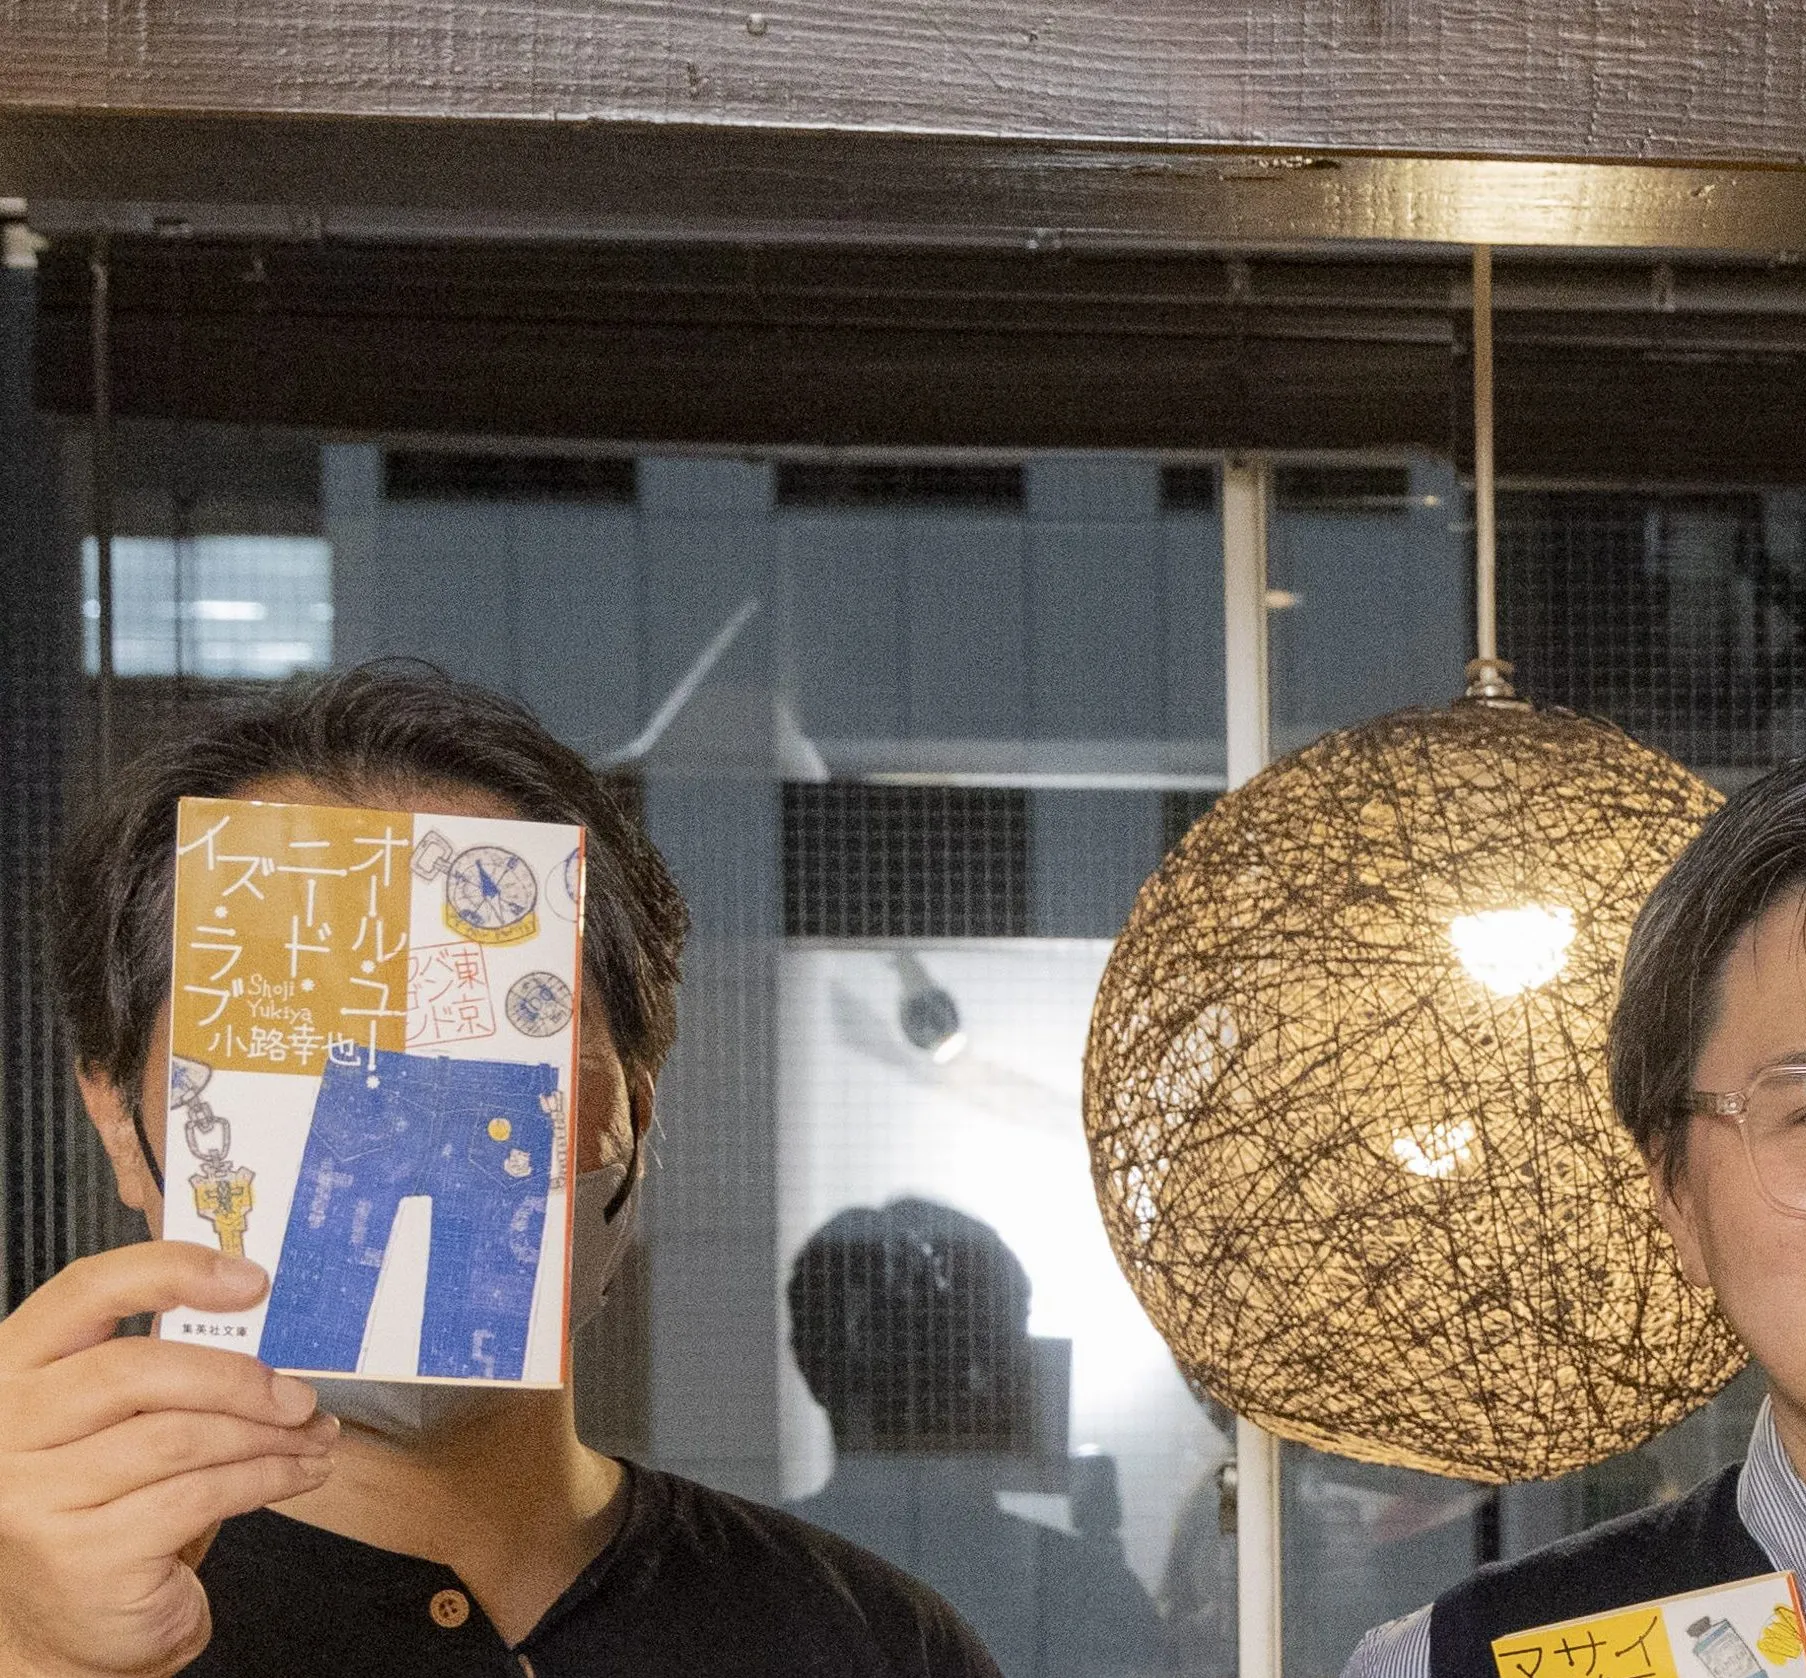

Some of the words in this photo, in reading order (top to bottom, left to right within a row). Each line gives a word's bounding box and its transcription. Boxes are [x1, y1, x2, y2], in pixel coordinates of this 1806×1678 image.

[248, 973, 297, 1001] Shoji
[419, 949, 455, 1039] バンド
[451, 948, 493, 1035] 東京
[247, 998, 313, 1026] Yukiya
[208, 1024, 361, 1067] 小路幸也
[182, 1323, 248, 1338] 集英社文庫
